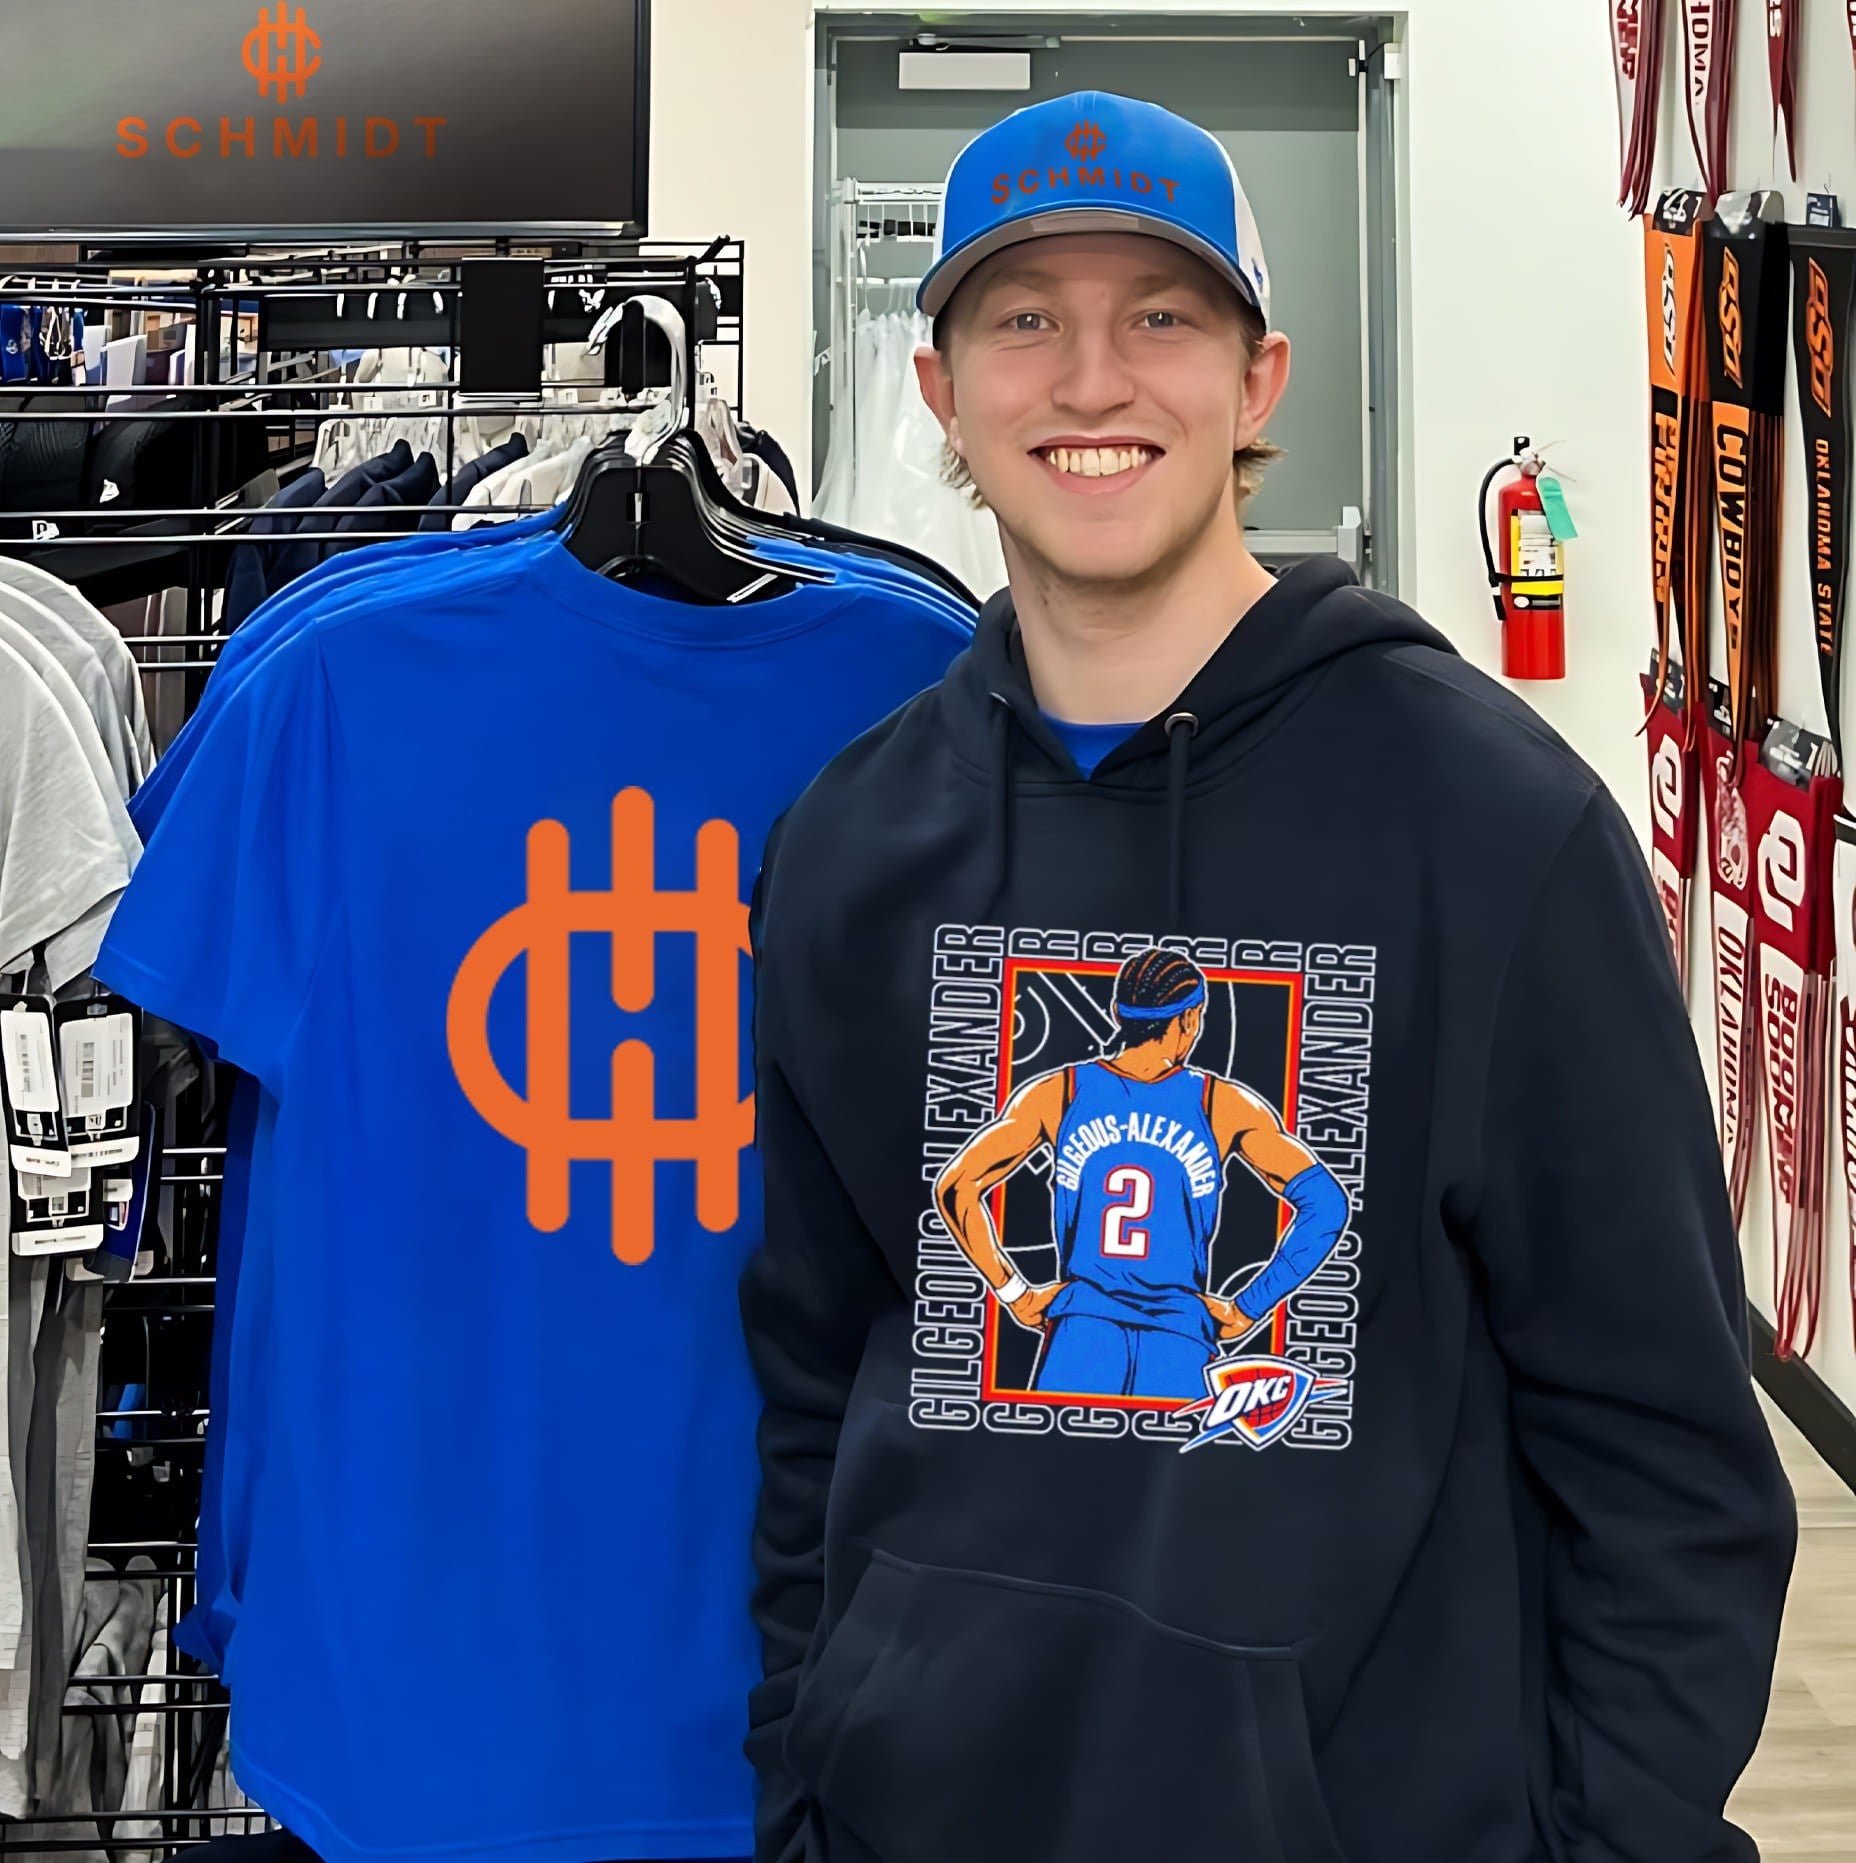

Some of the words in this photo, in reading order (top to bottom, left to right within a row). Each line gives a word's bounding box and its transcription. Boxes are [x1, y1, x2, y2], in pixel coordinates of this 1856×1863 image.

[115, 116, 448, 159] SCHMIDT
[991, 167, 1180, 205] SCHMIDT
[1055, 1111, 1217, 1199] GILGEOUS-ALEXANDER
[1101, 1164, 1155, 1260] 2
[1206, 1375, 1292, 1428] OKC
